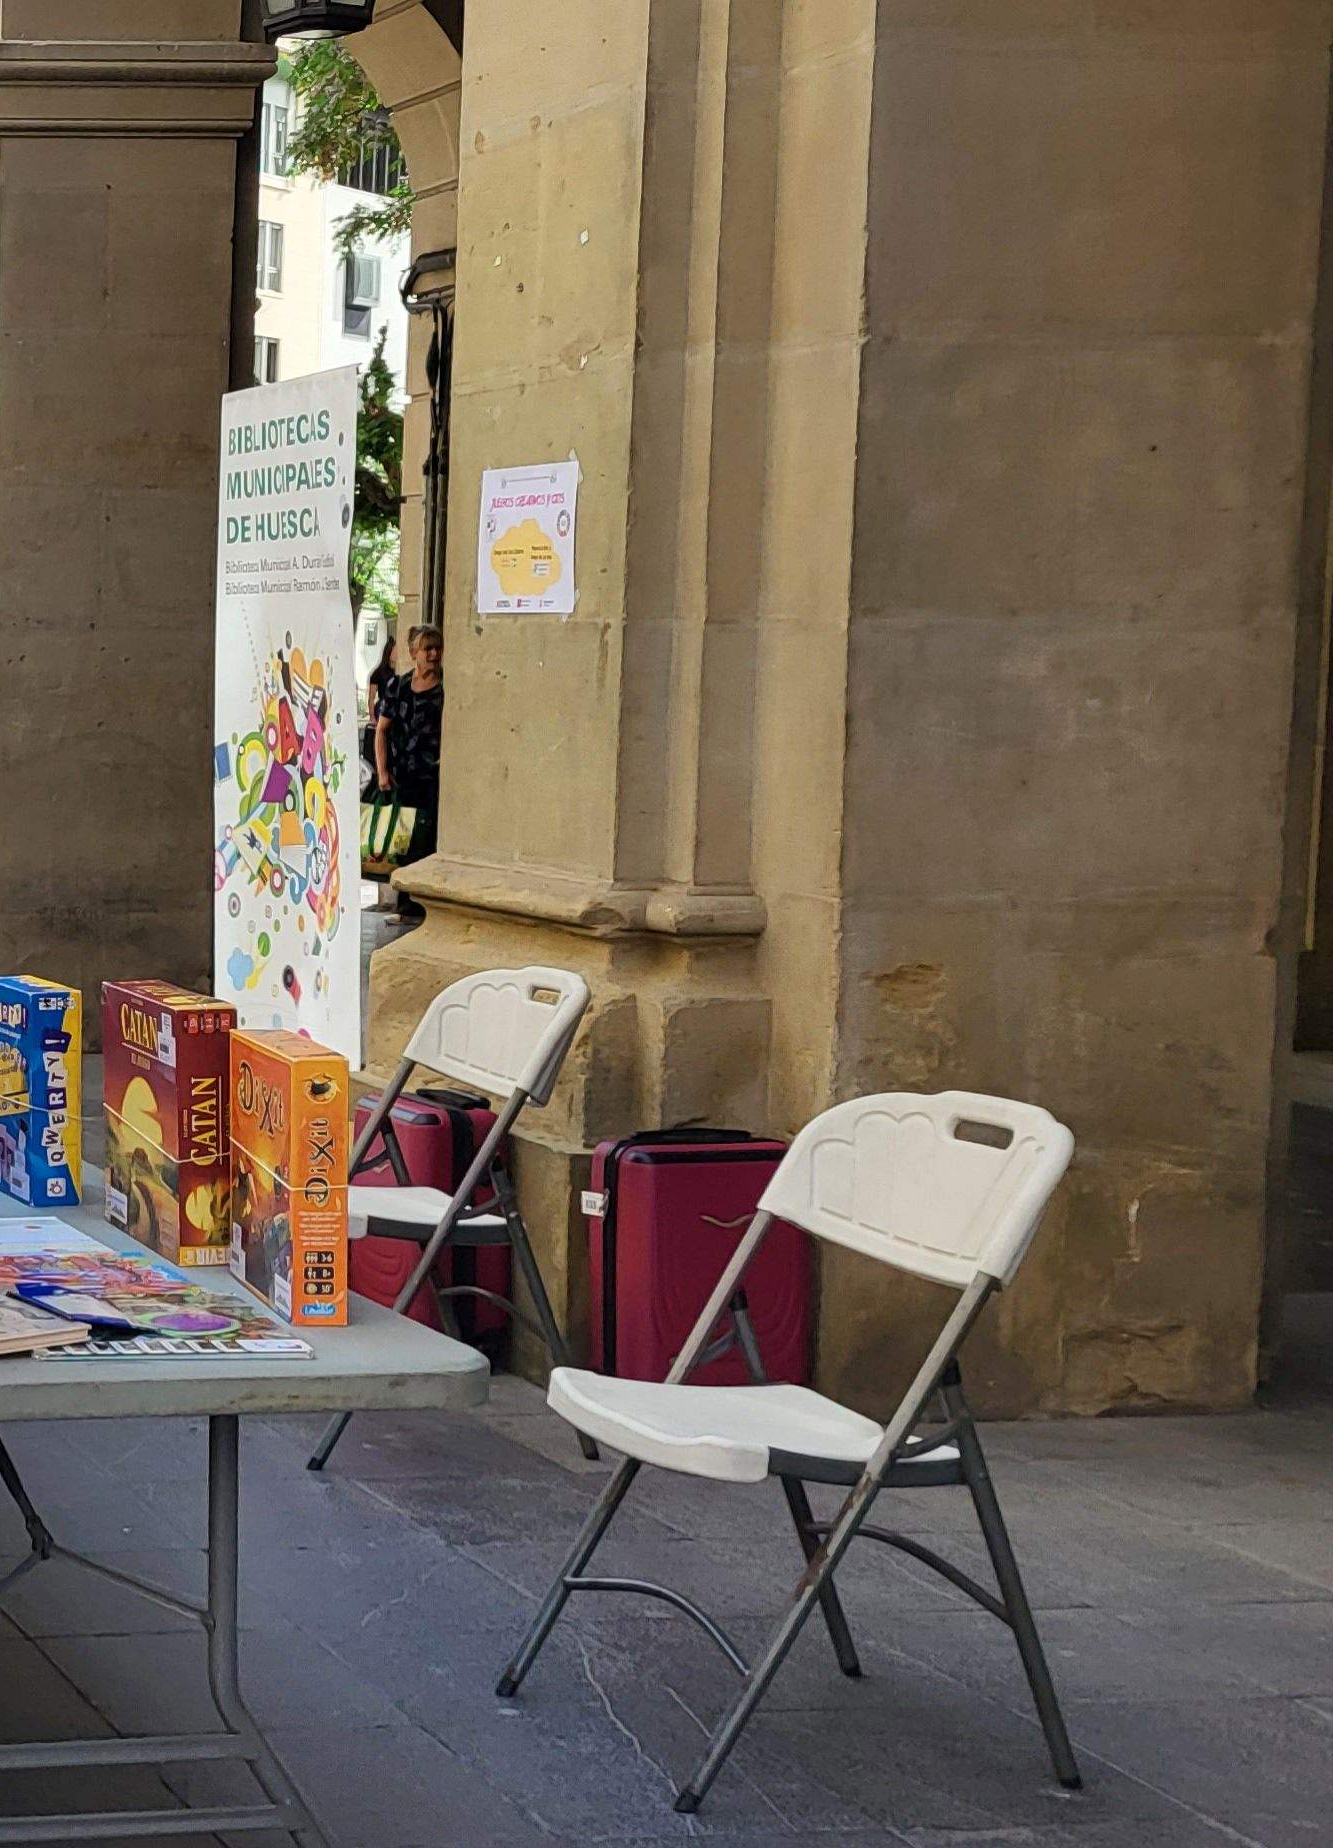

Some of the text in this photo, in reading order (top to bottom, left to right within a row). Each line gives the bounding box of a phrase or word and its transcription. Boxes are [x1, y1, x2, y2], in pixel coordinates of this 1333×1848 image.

[228, 409, 330, 456] BIBLIOTECAS
[226, 506, 321, 544] DE HUESCA
[120, 1003, 159, 1055] CATAN
[44, 1036, 68, 1164] QWERTY!
[190, 1077, 218, 1167] CATAN
